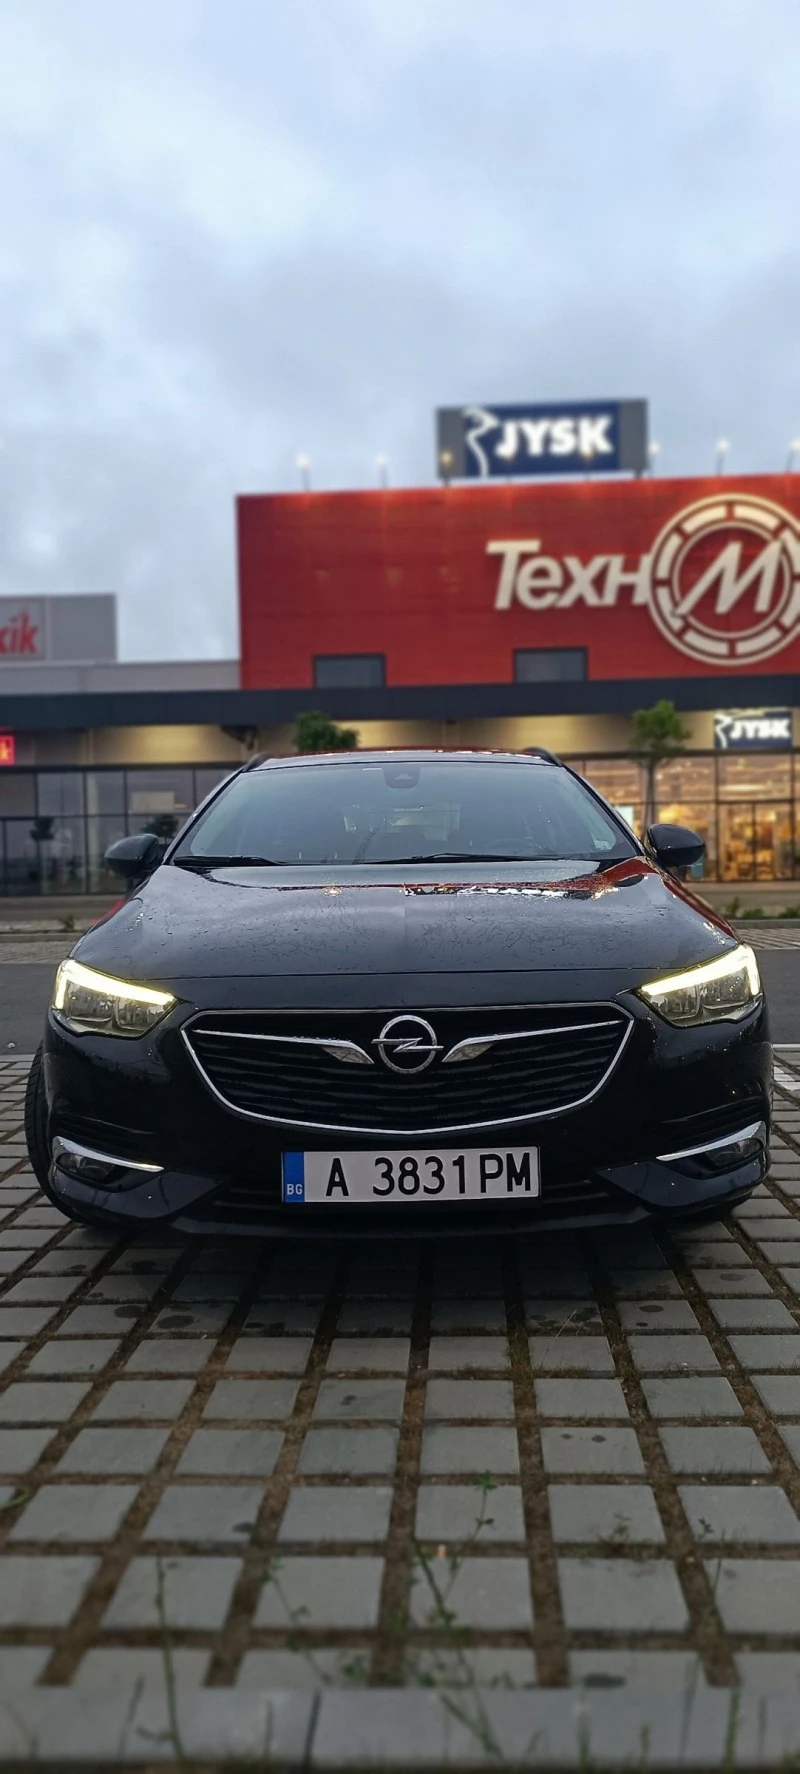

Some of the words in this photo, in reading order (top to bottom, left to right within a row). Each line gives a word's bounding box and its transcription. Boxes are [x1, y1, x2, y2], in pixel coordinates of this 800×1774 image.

[496, 415, 613, 456] JYSK
[729, 718, 791, 740] JYSK
[286, 1184, 303, 1196] BG
